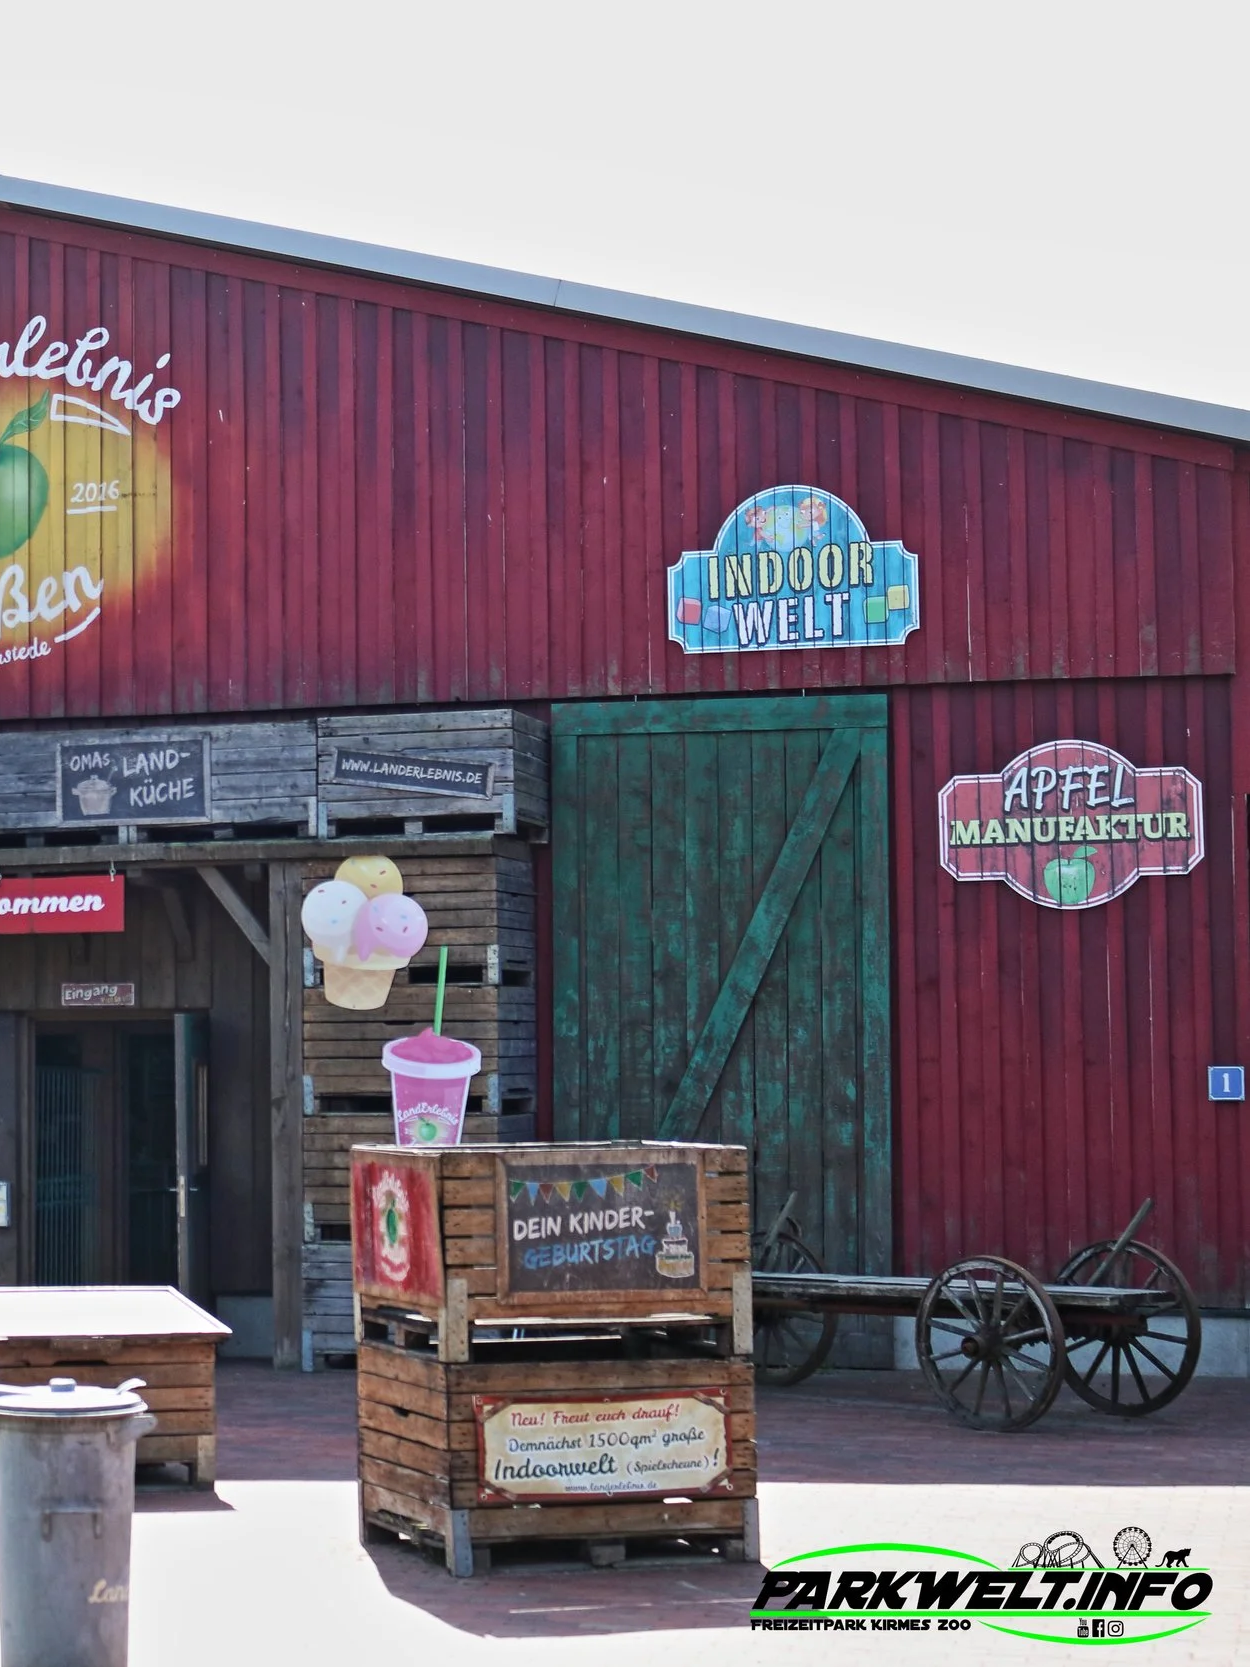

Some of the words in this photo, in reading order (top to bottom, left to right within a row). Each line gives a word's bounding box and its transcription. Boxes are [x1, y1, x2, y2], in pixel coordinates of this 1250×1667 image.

[71, 480, 120, 503] 2016
[707, 541, 874, 600] INDOOR
[733, 592, 851, 646] WELT
[69, 751, 111, 772] OMAS
[122, 749, 191, 777] LAND-
[341, 758, 483, 784] WWW.LANDERLEBNIS.DE
[130, 777, 195, 808] KÜCHE
[1004, 763, 1135, 813] APFEL
[949, 812, 1192, 847] MANUFAKTUR
[65, 985, 118, 1001] Eingang
[1222, 1072, 1230, 1093] 1
[513, 1216, 562, 1241] DEIN
[569, 1206, 655, 1234] KINDER-
[524, 1234, 657, 1270] GEBURTSTAG
[511, 1412, 546, 1427] Neu!
[553, 1410, 590, 1425] Freut
[595, 1408, 626, 1422] euch
[632, 1404, 680, 1423] drauf!
[508, 1436, 582, 1453] Demnächst
[662, 1426, 705, 1448] große
[494, 1452, 617, 1481] Indoorwelt
